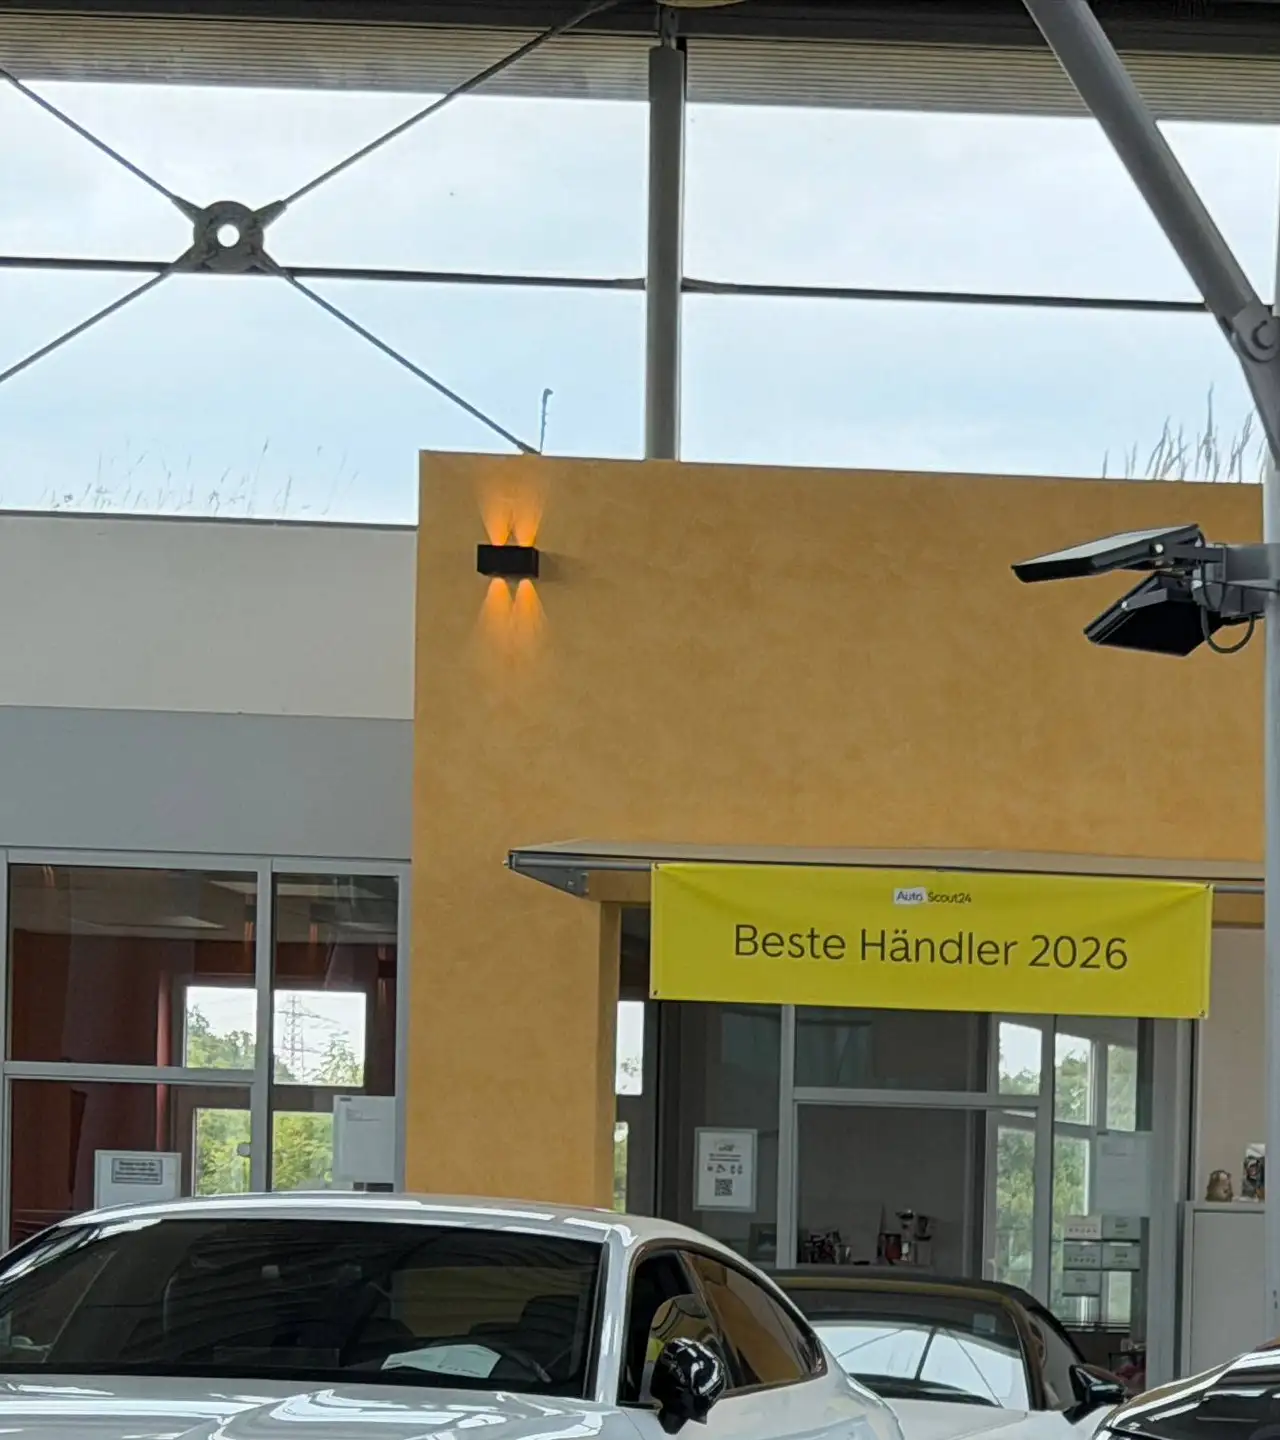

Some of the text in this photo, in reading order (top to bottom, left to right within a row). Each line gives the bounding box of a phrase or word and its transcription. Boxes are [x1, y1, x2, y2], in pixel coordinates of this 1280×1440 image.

[896, 891, 972, 904] Auto Scout24
[734, 923, 1129, 971] Beste Händler 2026
